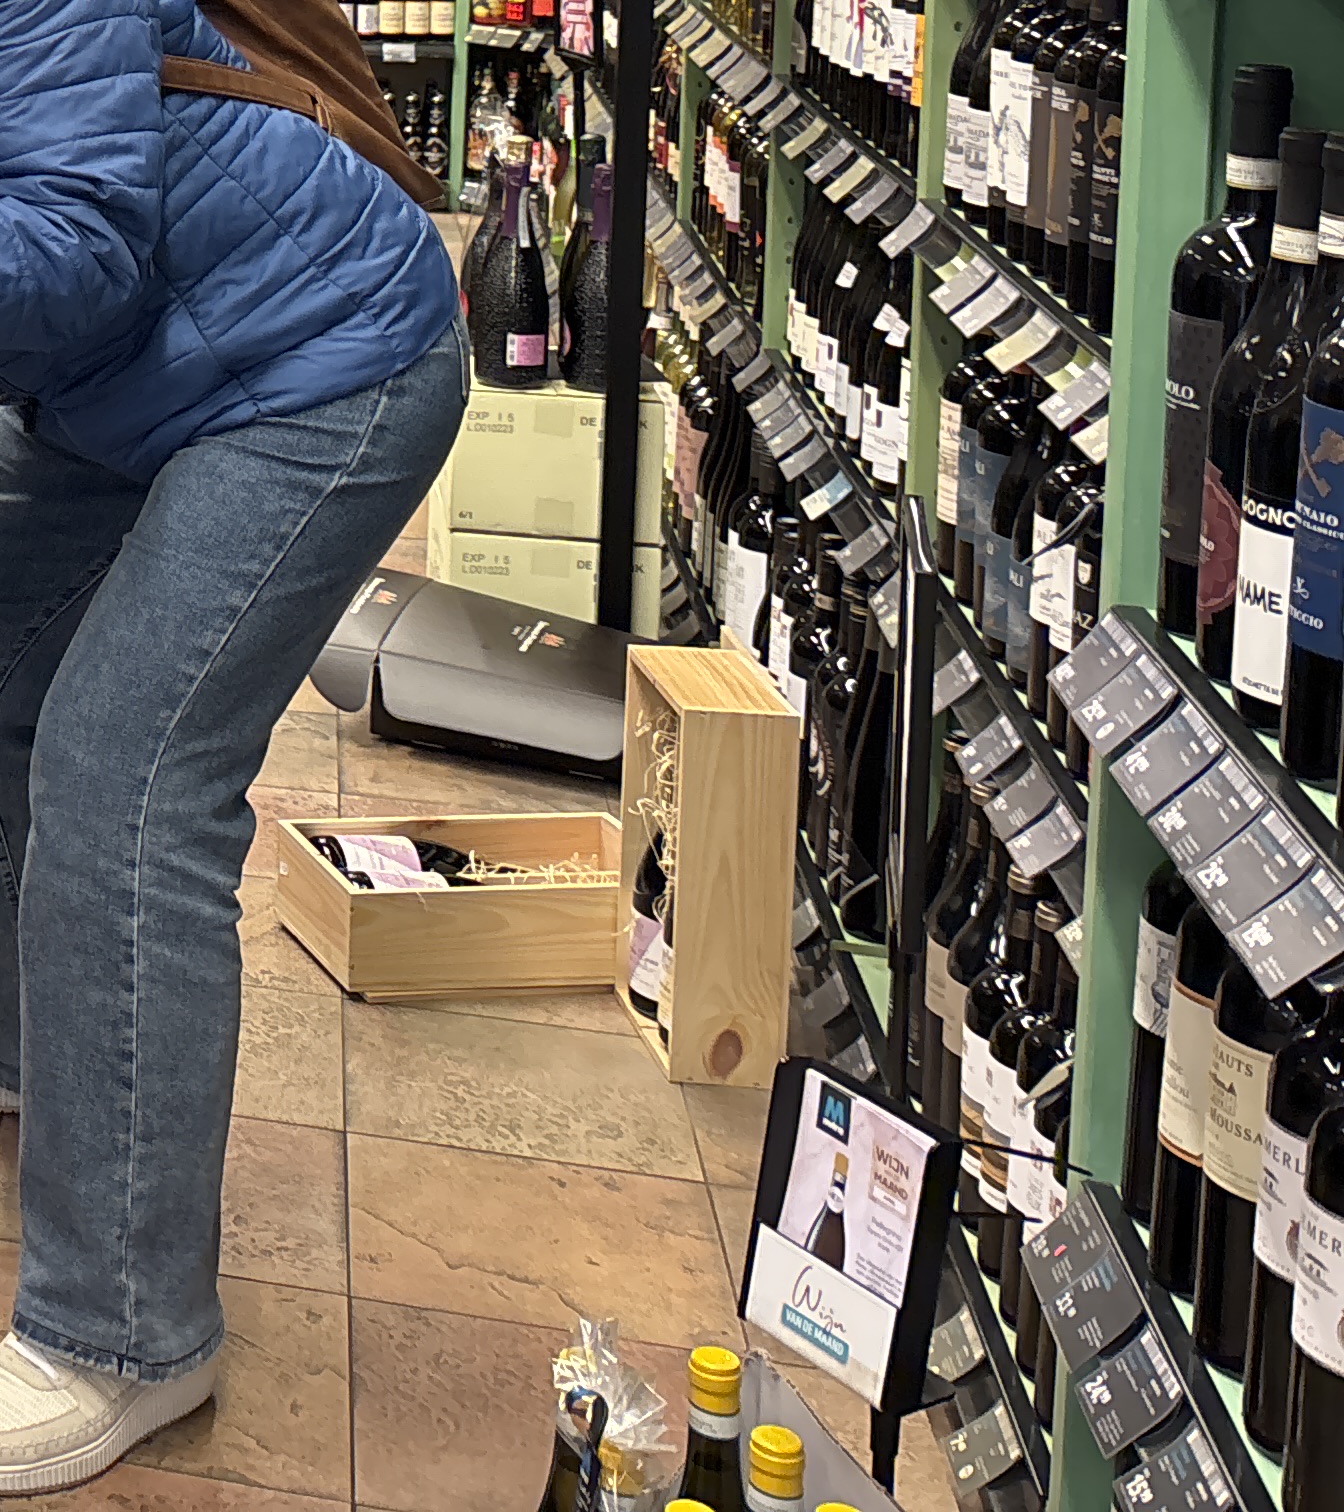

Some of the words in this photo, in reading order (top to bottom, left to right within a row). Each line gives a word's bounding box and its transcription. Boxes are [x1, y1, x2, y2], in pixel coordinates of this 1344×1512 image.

[467, 411, 490, 422] EXP
[462, 553, 486, 564] EXP
[876, 1145, 910, 1181] WIJN
[792, 1265, 846, 1333] Wijn
[785, 1308, 802, 1330] VAN
[803, 1318, 814, 1336] DE
[814, 1326, 845, 1356] MAAND
